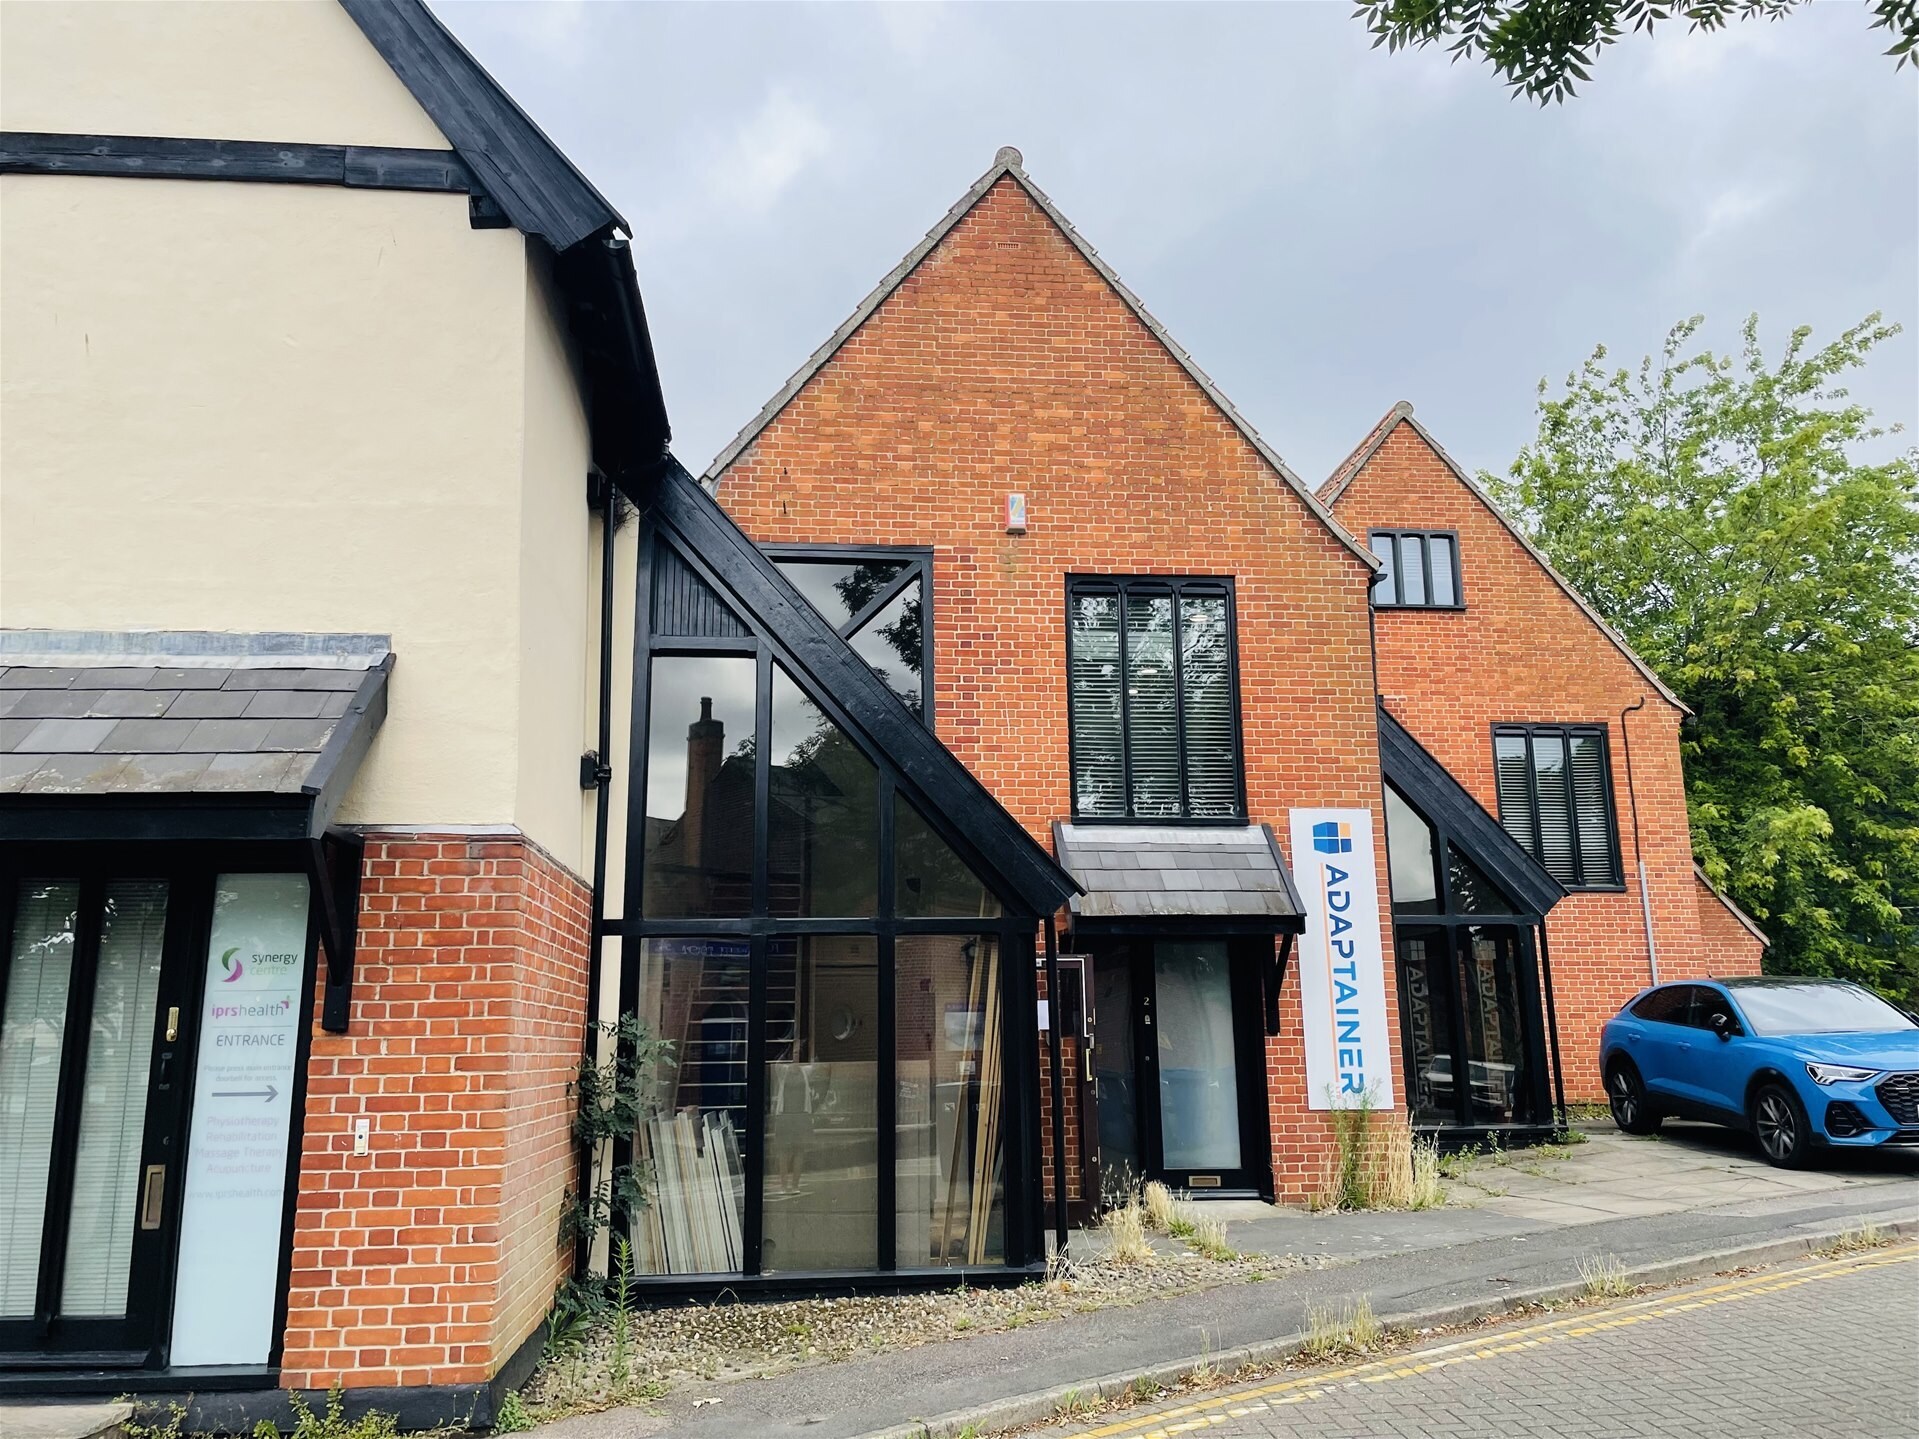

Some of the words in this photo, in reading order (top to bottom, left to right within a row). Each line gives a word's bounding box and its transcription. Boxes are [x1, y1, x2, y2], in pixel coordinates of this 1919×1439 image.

[251, 954, 298, 965] synergy
[250, 966, 287, 976] centre
[1326, 864, 1366, 1095] ADAPTAINER
[1143, 996, 1150, 1006] 2
[211, 1003, 284, 1019] iprshealth
[216, 1034, 286, 1047] ENTRANCE
[207, 1117, 280, 1127] Physiotherapy
[206, 1133, 278, 1143] Rehabilitation
[206, 1164, 272, 1174] Acupuncture
